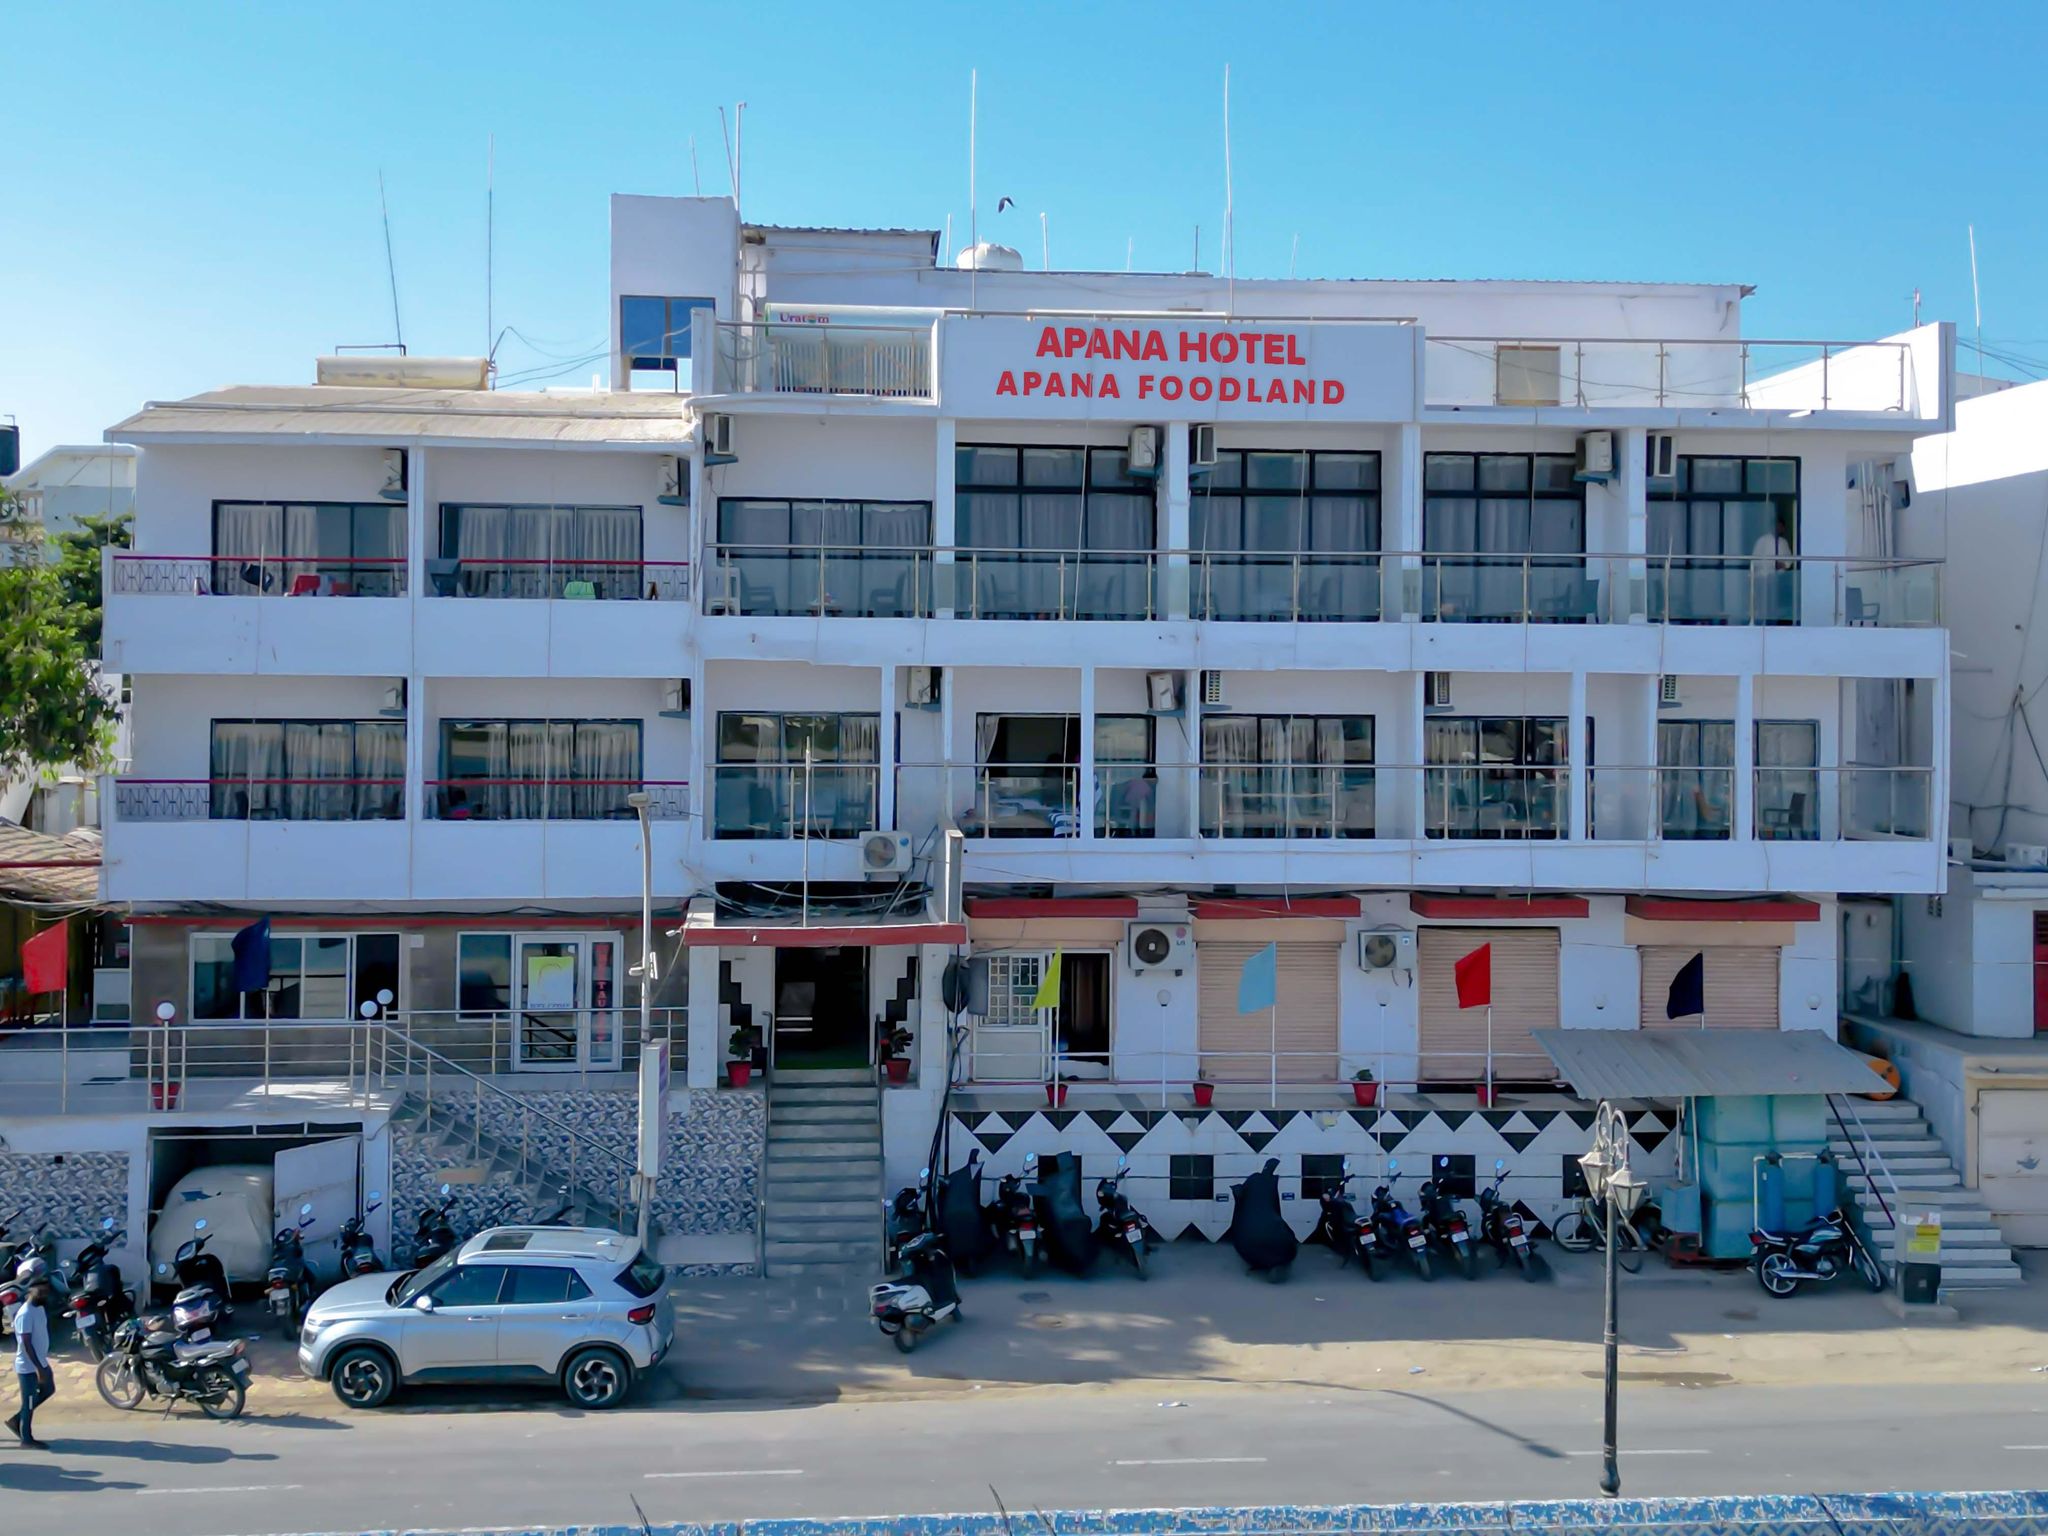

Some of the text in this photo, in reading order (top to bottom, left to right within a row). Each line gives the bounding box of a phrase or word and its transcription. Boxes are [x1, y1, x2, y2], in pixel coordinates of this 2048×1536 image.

[1036, 327, 1305, 365] APANA HOTEL
[996, 371, 1344, 404] APANA FOODLAND
